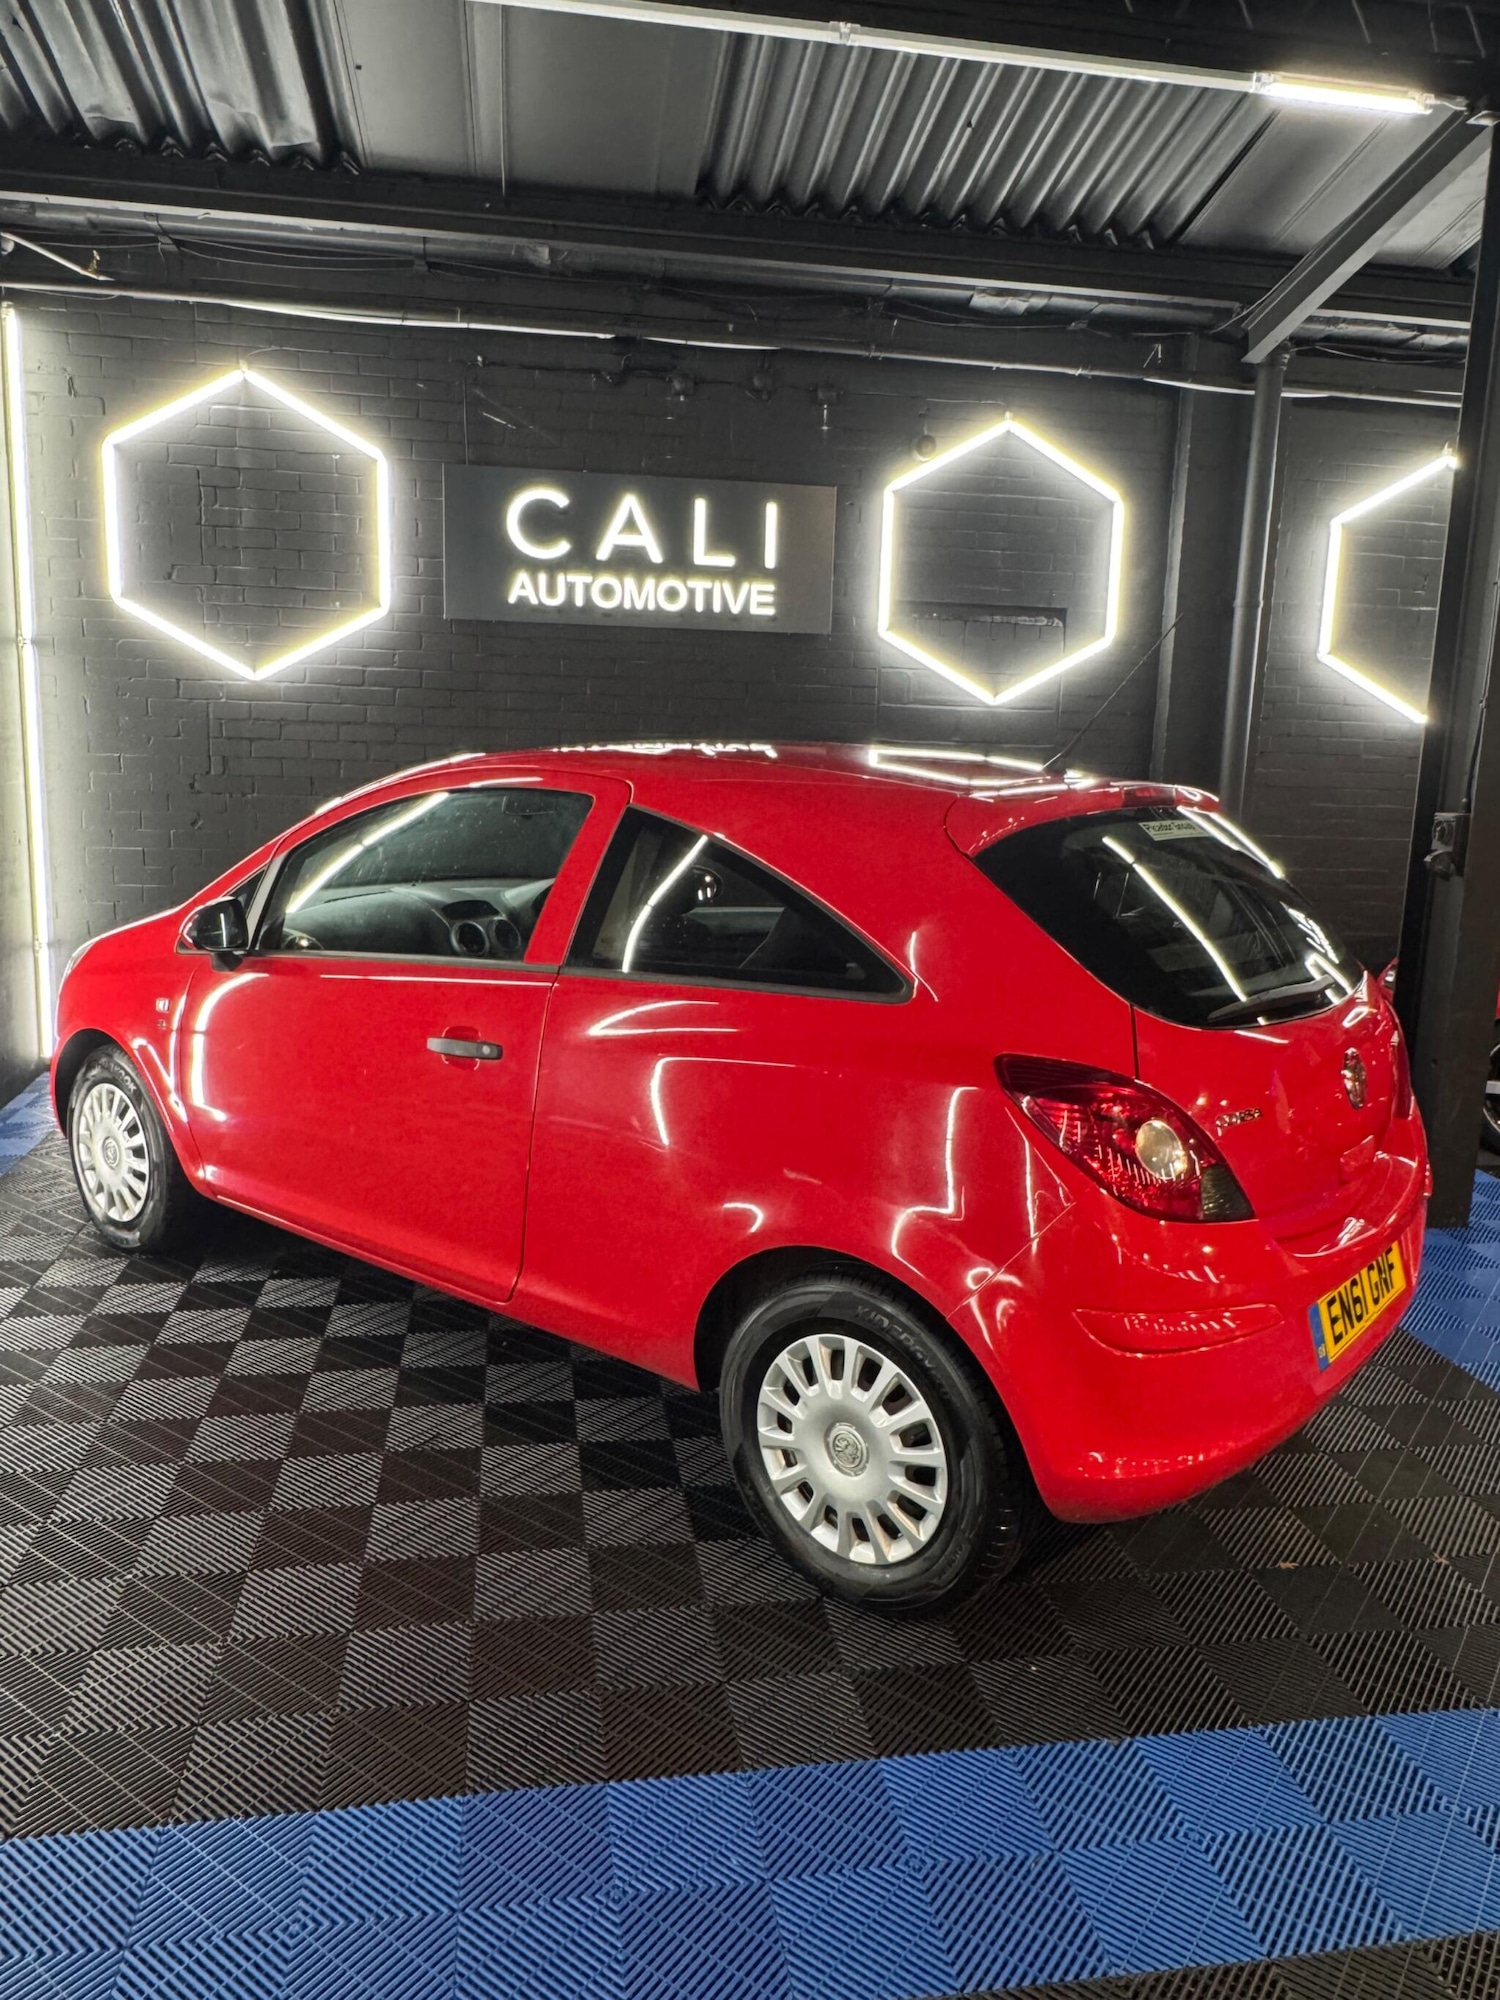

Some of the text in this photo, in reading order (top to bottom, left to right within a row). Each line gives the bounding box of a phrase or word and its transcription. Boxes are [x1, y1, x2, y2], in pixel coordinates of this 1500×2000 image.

[506, 486, 778, 569] CALI
[507, 571, 777, 616] AUTOMOTIVE
[1326, 1245, 1395, 1346] EN61 GNF
